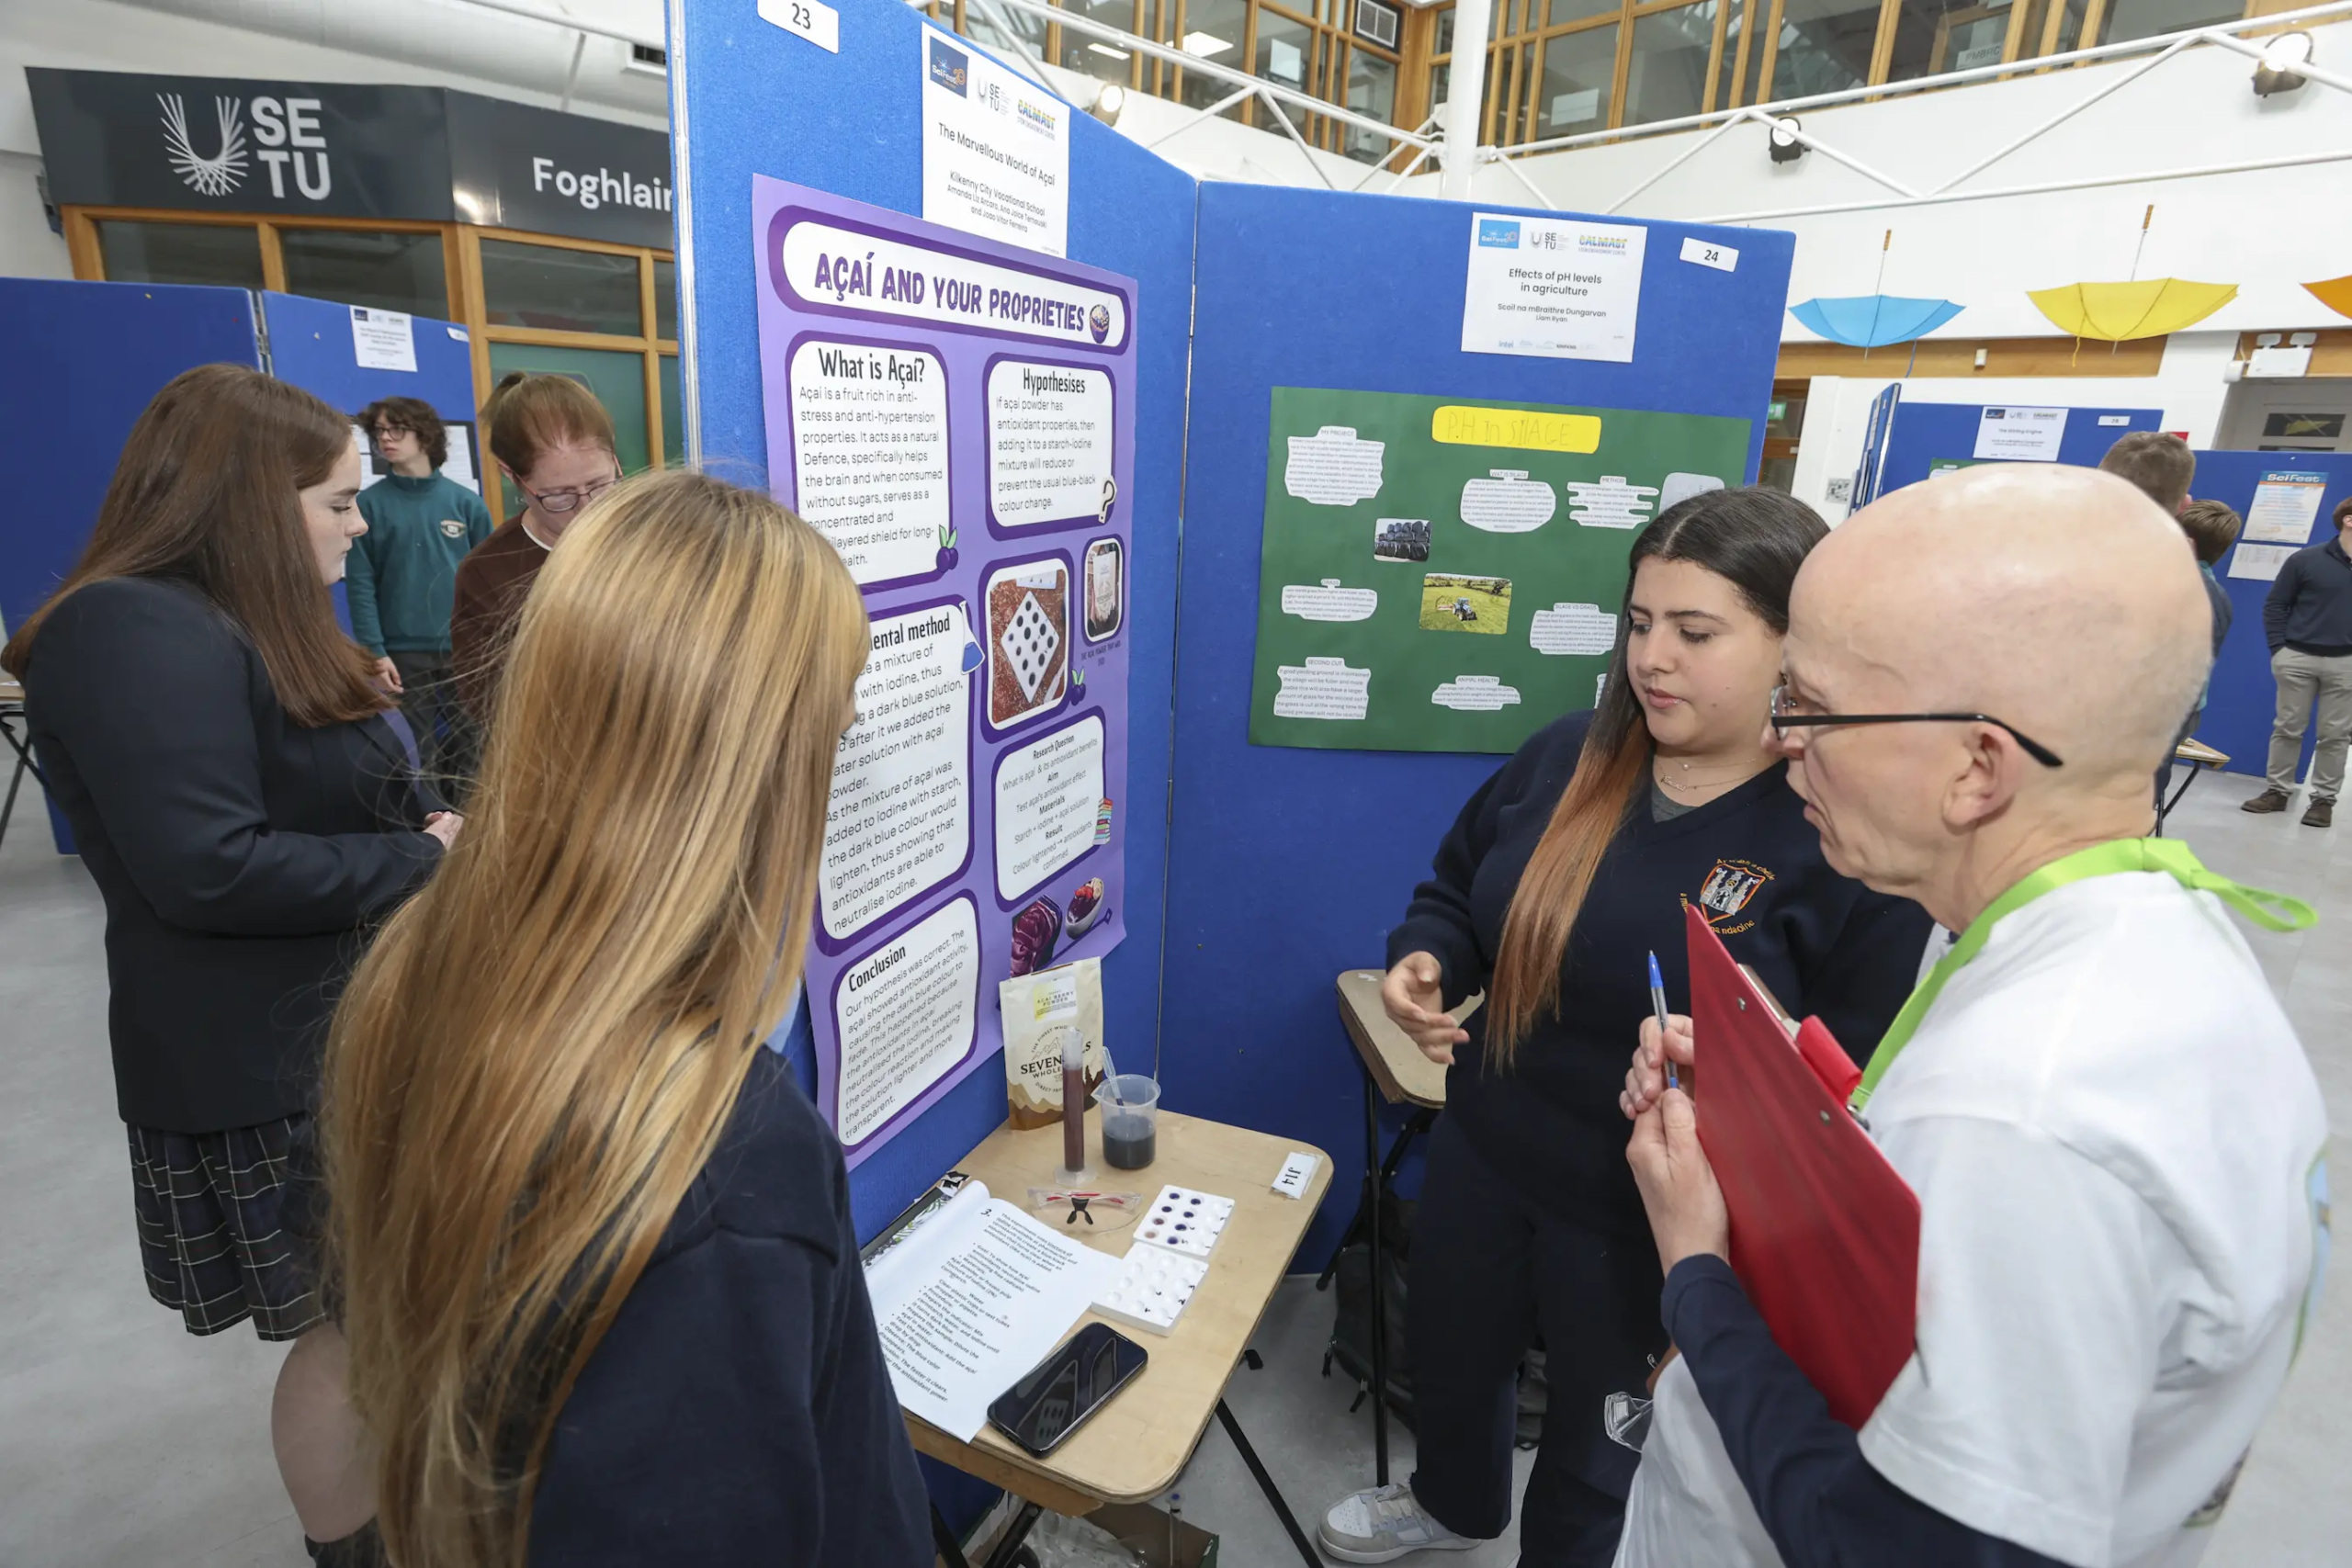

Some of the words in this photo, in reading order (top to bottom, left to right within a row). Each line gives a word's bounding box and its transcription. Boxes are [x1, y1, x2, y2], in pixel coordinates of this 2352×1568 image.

[792, 3, 810, 29] 23
[989, 84, 1001, 98] SE
[989, 96, 1000, 111] TU
[252, 96, 327, 149] SE
[1018, 99, 1056, 130] CALMAST
[938, 122, 955, 141] The
[957, 131, 1003, 164] Marvellous
[1005, 153, 1028, 175] World
[1030, 165, 1037, 178] of
[256, 151, 333, 201] TU
[947, 184, 972, 200] Amanda
[1001, 205, 1011, 214] Ana
[950, 171, 978, 193] Kilkenny
[979, 183, 992, 197] City
[994, 188, 1025, 209] Vocational
[1026, 202, 1045, 217] School
[971, 206, 982, 217] and
[997, 214, 1009, 225] Vitor
[1009, 220, 1028, 232] Ferreira
[1544, 231, 1556, 241] SE
[1578, 235, 1628, 250] CALMAST
[1544, 241, 1556, 251] TU
[1703, 249, 1719, 263] 24
[1509, 268, 1544, 280] Effects
[1545, 270, 1555, 281] of
[1556, 272, 1571, 283] pH
[1573, 273, 1602, 285] levels
[814, 252, 875, 302] AÇAÍ
[881, 266, 924, 305] AND
[933, 276, 983, 315] YOUR
[989, 288, 1085, 333] PROPRIETIES
[1521, 283, 1530, 292] in
[1532, 284, 1588, 298] agriculture
[1498, 303, 1516, 311] Scoil
[1528, 306, 1565, 314] mBraithre
[1566, 308, 1606, 318] Dungarvan
[1498, 340, 1514, 349] intel
[818, 348, 864, 379] What
[869, 353, 882, 380] is
[1023, 367, 1086, 397] Hypothesises
[824, 388, 833, 400] is
[834, 390, 841, 400] a
[842, 388, 864, 401] fruit
[866, 389, 885, 401] rich
[887, 390, 896, 402] in
[897, 390, 918, 403] anti-
[996, 397, 1003, 409] If
[1022, 398, 1049, 412] powder
[1051, 400, 1063, 411] has
[800, 411, 832, 423] stress
[834, 411, 854, 423] and
[856, 411, 935, 425] anti-hypertension
[997, 419, 1041, 431] antioxidant
[1042, 419, 1079, 434] properties,
[1080, 420, 1095, 431] then
[803, 432, 858, 449] properties.
[860, 432, 867, 443] It
[869, 433, 889, 443] acts
[891, 433, 901, 443] as
[903, 433, 909, 443] a
[910, 431, 939, 442] natural
[1330, 429, 1354, 437] PROJECT
[804, 452, 850, 466] Defence,
[852, 450, 903, 467] specifically
[905, 450, 928, 464] helps
[2267, 474, 2321, 482] SciFest
[999, 500, 1023, 513] colour
[1024, 497, 1053, 511] change.
[908, 612, 951, 641] method
[1033, 743, 1054, 760] Research
[1055, 735, 1074, 751] Question
[1047, 772, 1058, 783] Aim
[841, 801, 859, 817] the
[861, 784, 900, 810] mixture
[902, 776, 913, 790] of
[935, 761, 952, 776] was
[827, 818, 862, 846] added
[864, 816, 875, 828] to
[876, 801, 908, 825] iodine
[910, 790, 930, 807] with
[932, 776, 962, 797] starch,
[1039, 795, 1065, 816] Materials
[828, 851, 847, 868] the
[848, 838, 873, 858] dark
[875, 827, 897, 845] blue
[898, 813, 929, 834] colour
[930, 795, 957, 818] would
[1046, 825, 1063, 840] Result
[1043, 849, 1069, 871] confirmed
[834, 895, 885, 932] neutralise
[886, 877, 918, 900] iodine.
[845, 1000, 862, 1017] Our
[864, 968, 908, 1005] hypothesis
[908, 959, 922, 974] was
[923, 939, 951, 963] correct.
[951, 930, 965, 943] The
[848, 946, 906, 992] Conclusion
[845, 1096, 896, 1139] transparent.
[1281, 1166, 1302, 1186] J14
[980, 1208, 992, 1216] 3.
[906, 1342, 915, 1352] The
[915, 1348, 926, 1361] blue
